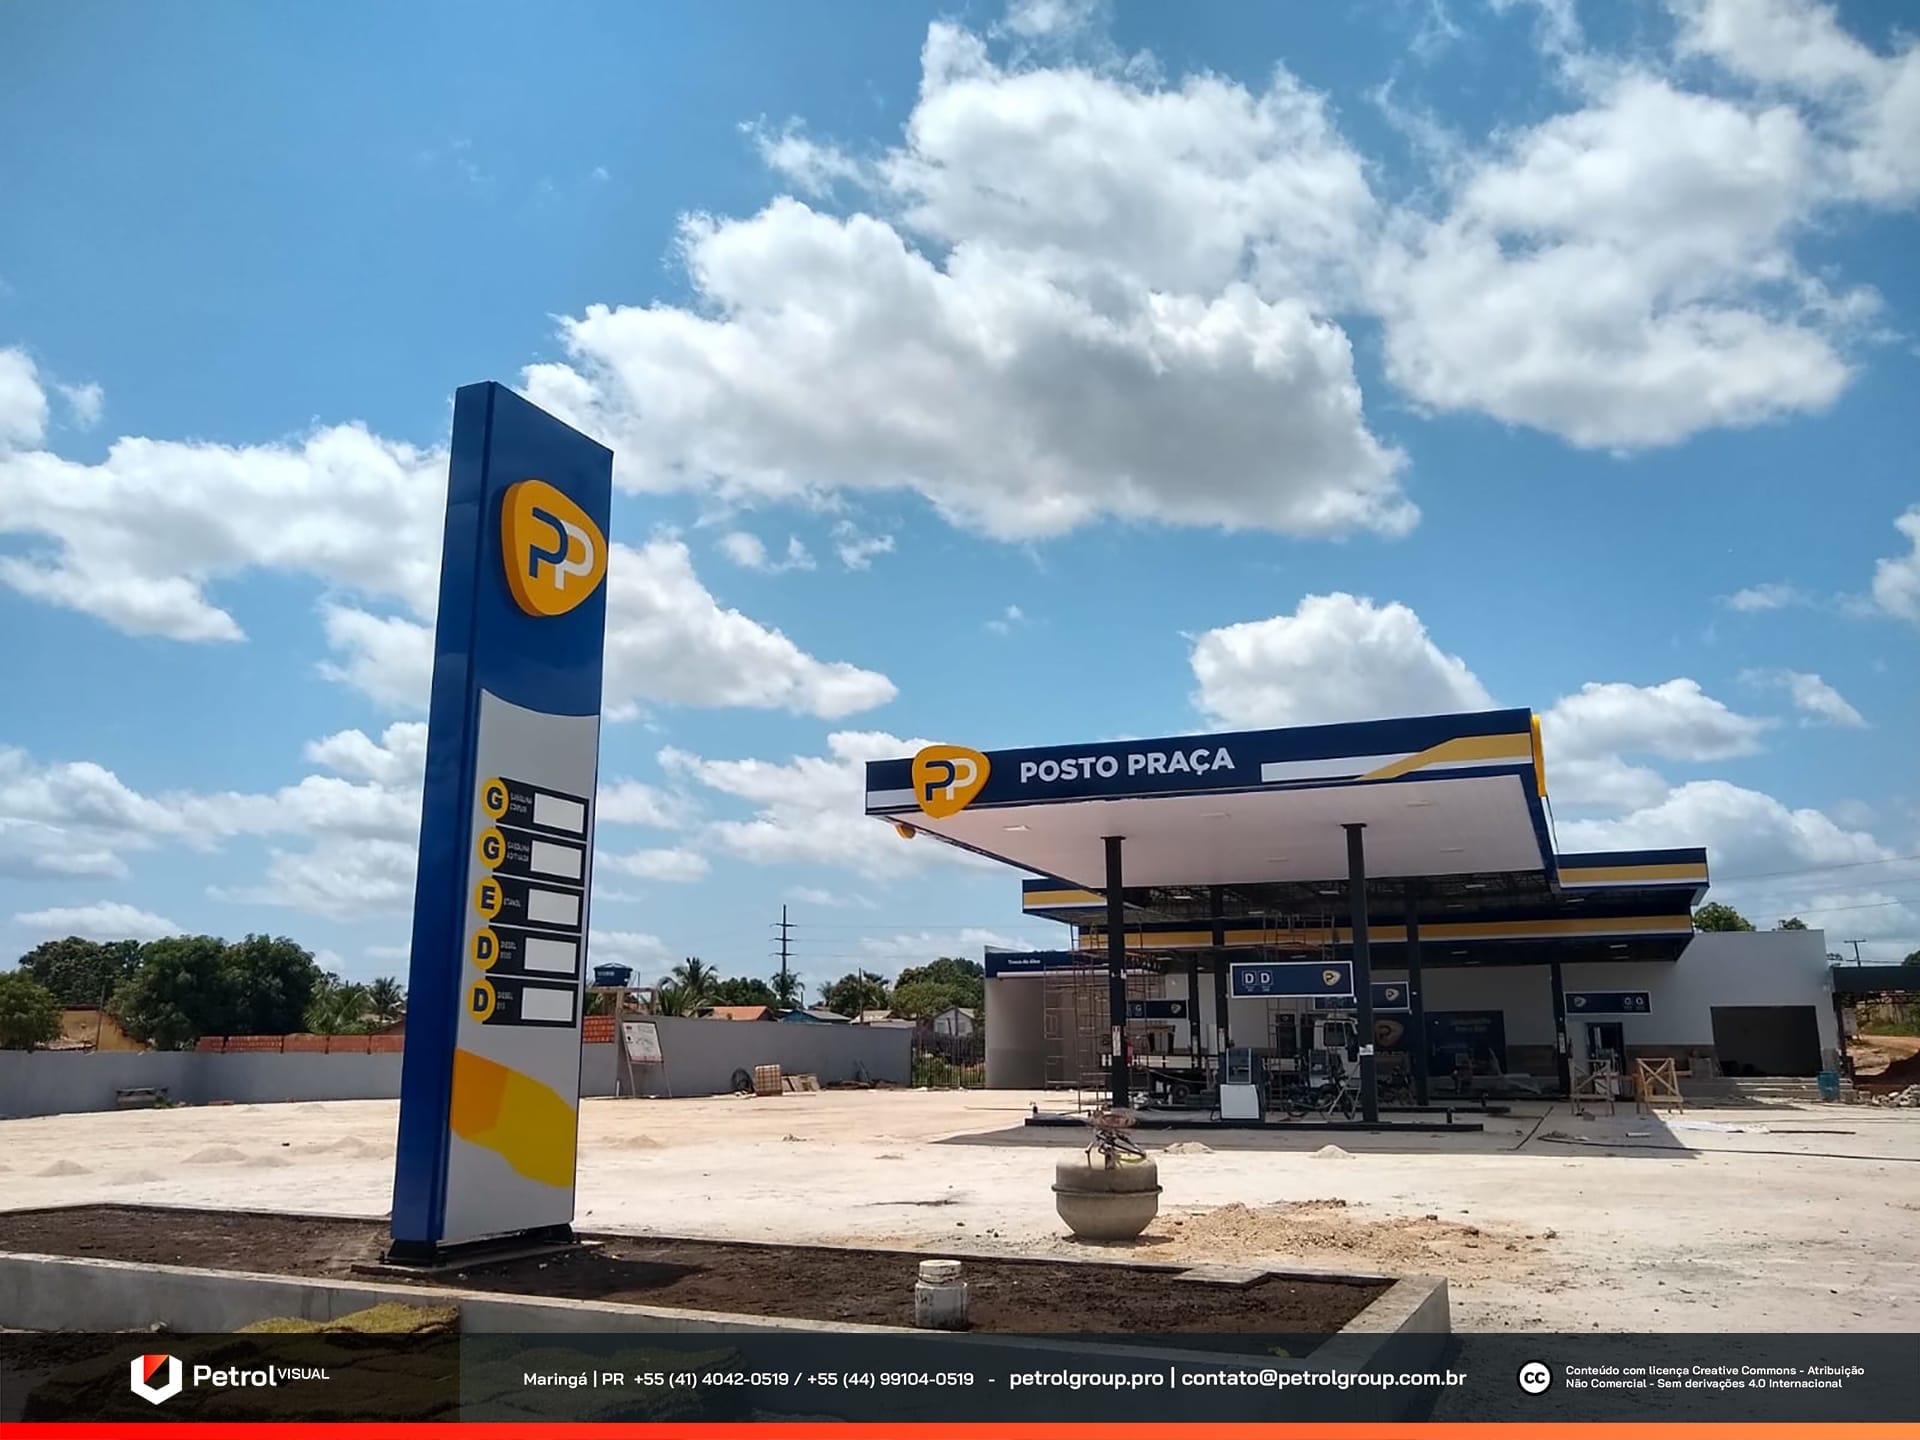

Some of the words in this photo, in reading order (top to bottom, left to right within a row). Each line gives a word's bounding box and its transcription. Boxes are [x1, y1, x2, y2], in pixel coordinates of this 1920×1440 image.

[528, 506, 594, 590] PP
[1019, 755, 1119, 784] POSTO
[1127, 747, 1236, 776] PRAÇA
[486, 786, 504, 811] G
[482, 836, 500, 860] G
[480, 885, 496, 911] E
[476, 935, 492, 960] D
[1244, 972, 1255, 985] D
[1260, 971, 1271, 985] D
[472, 987, 489, 1013] D
